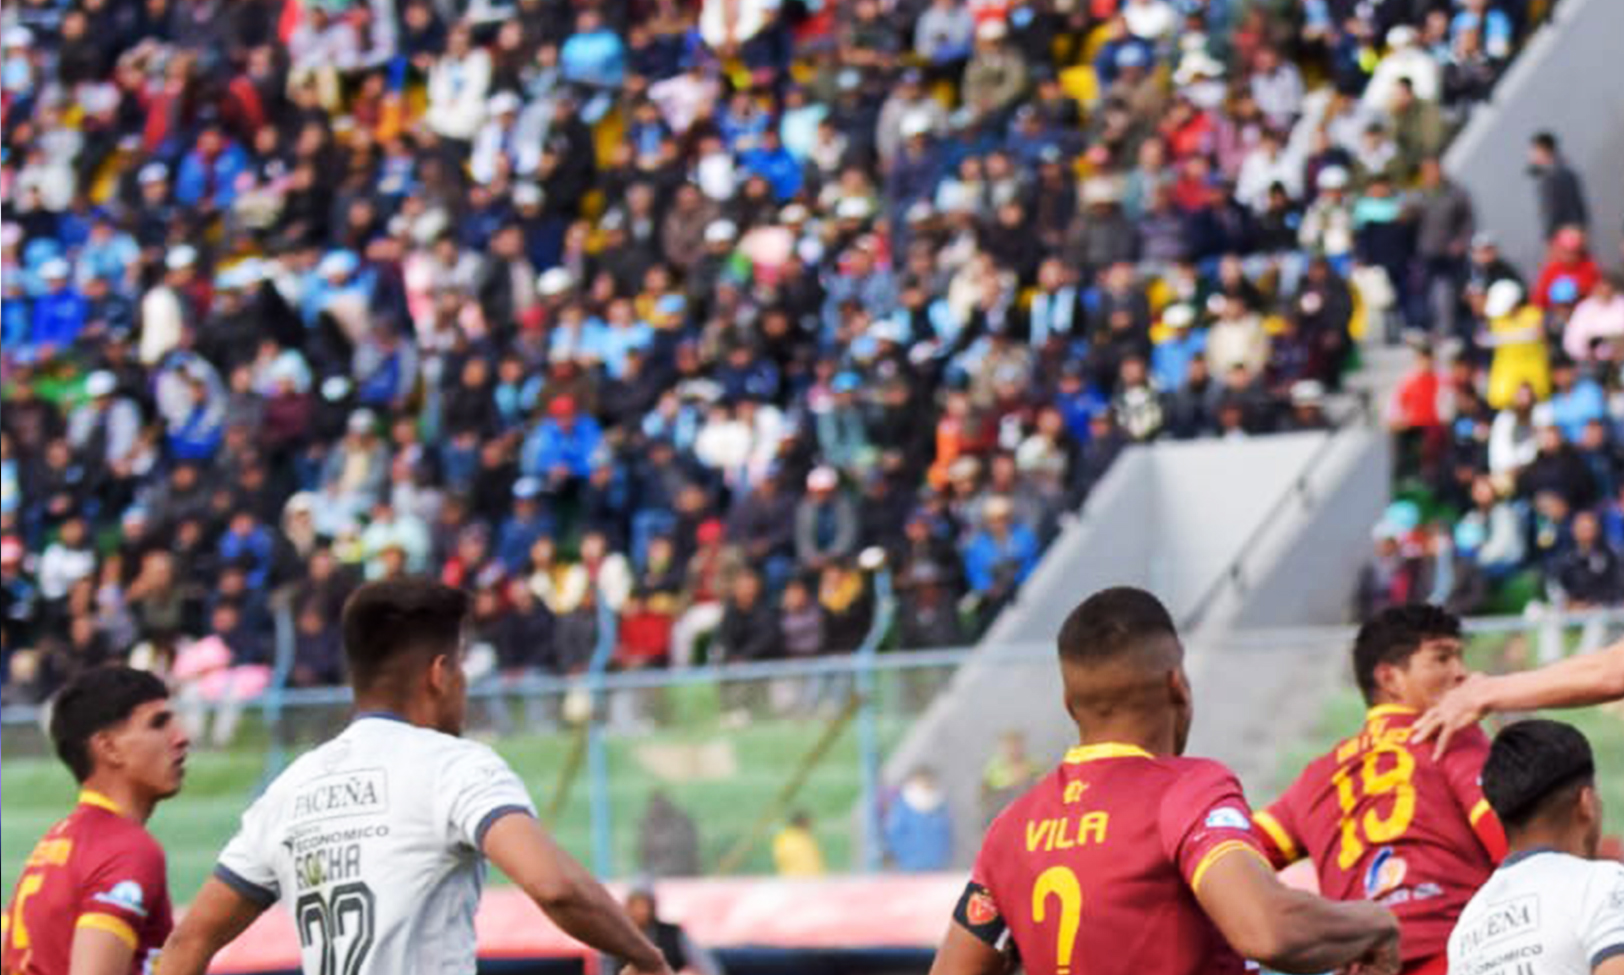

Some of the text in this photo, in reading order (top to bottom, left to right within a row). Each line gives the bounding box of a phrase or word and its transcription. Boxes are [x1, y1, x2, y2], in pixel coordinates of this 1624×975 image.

[1332, 744, 1416, 870] 19
[1026, 810, 1109, 852] VILA
[294, 843, 361, 888] ROCHA
